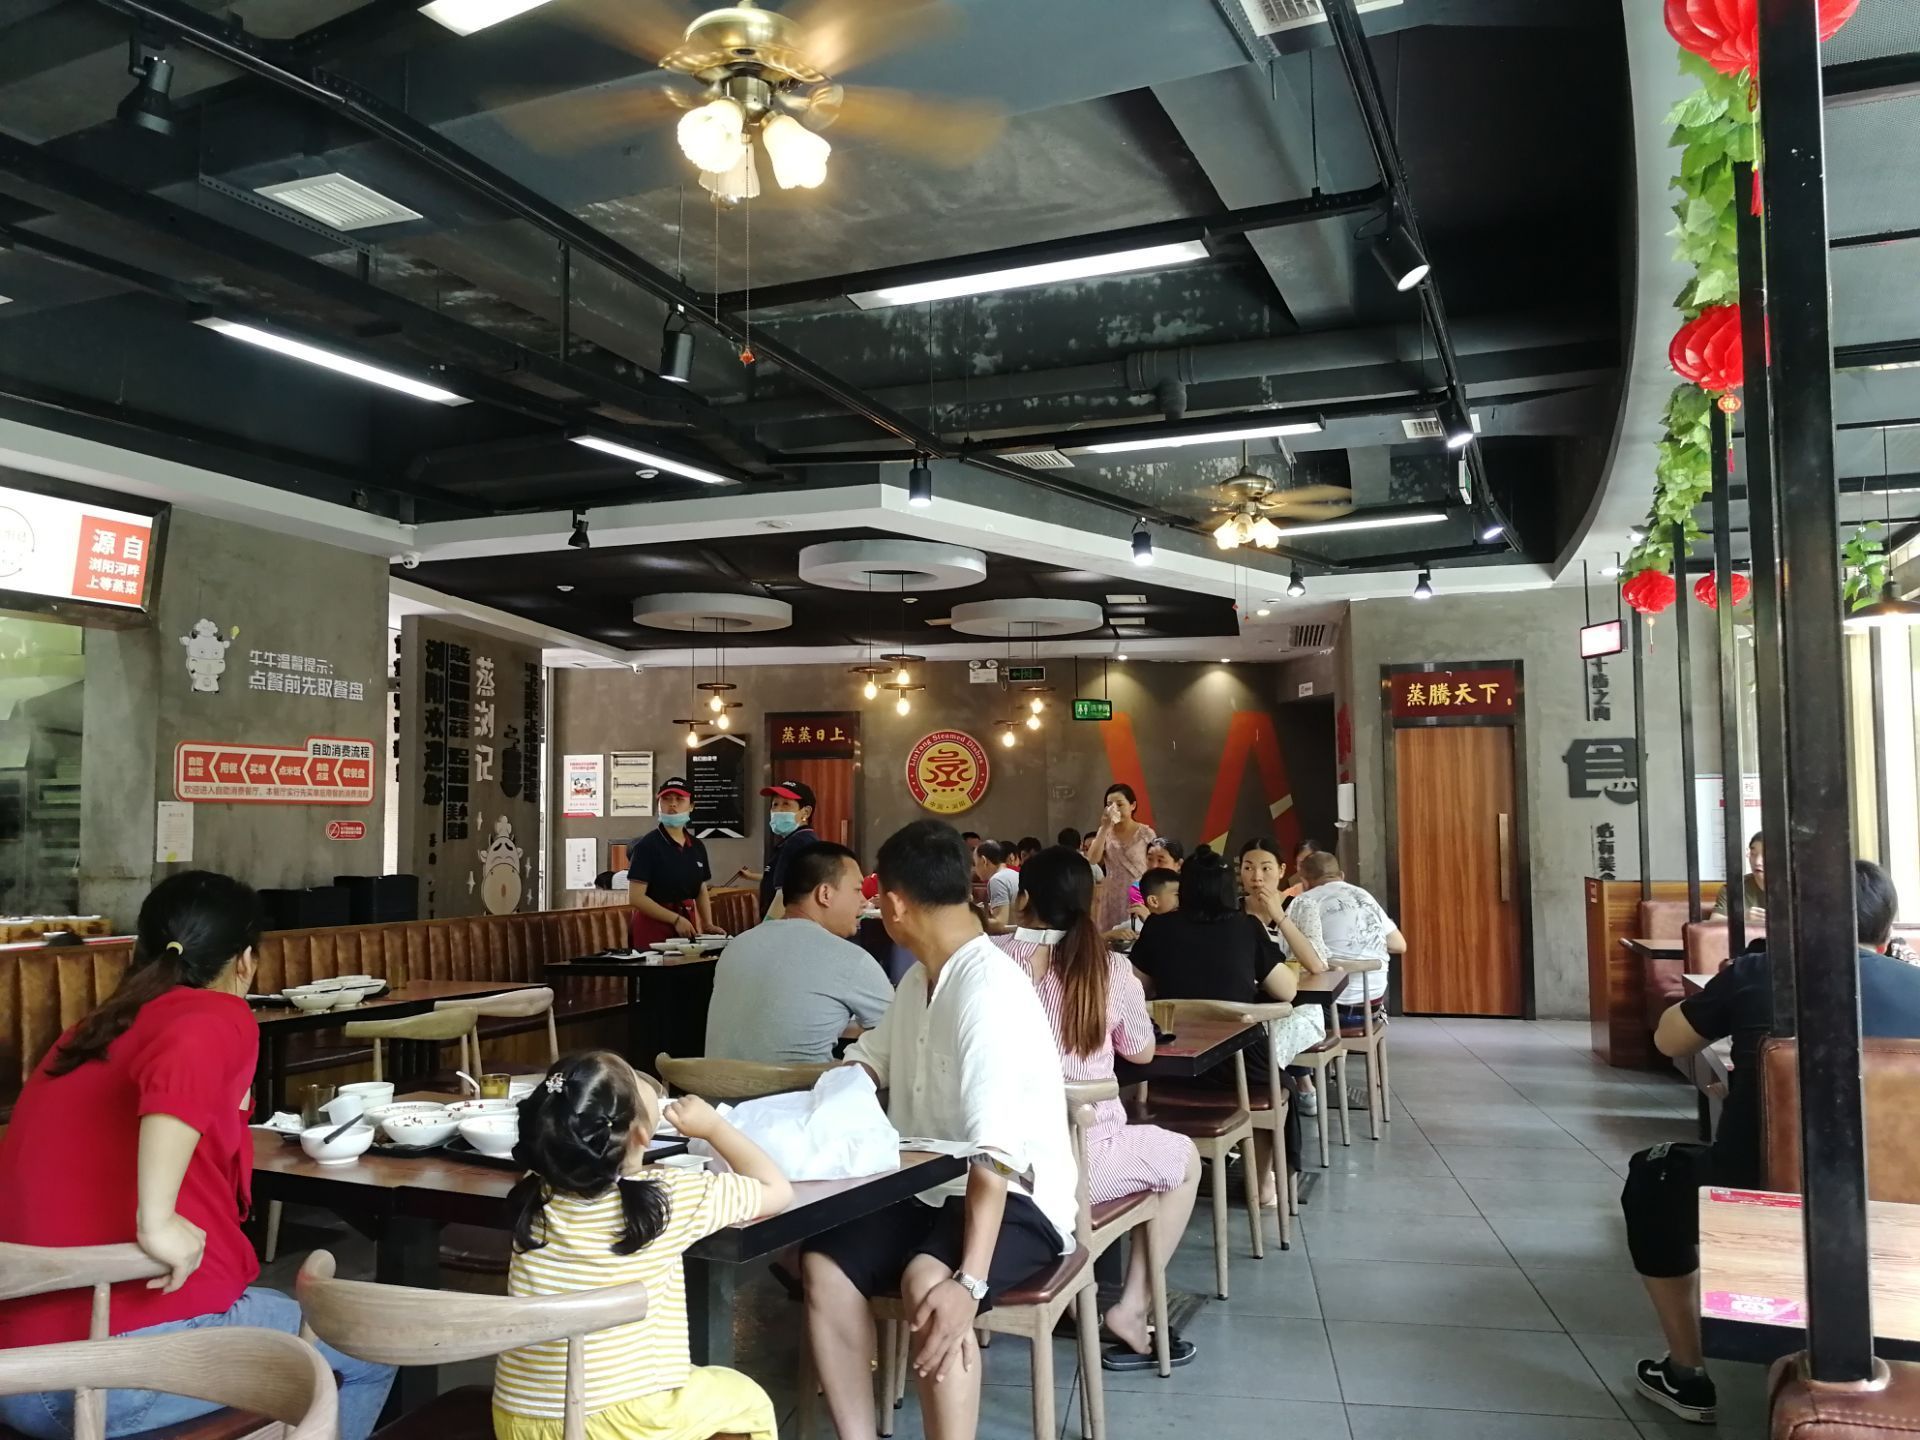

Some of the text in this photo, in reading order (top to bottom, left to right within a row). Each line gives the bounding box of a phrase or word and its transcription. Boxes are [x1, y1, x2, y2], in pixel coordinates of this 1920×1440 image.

[91, 529, 144, 561] 源自
[88, 557, 140, 578] 浏阳河畔
[85, 575, 138, 595] 上等蒸菜
[249, 670, 364, 701] 点餐前先取餐盘
[474, 656, 495, 782] 蒸浏记
[781, 726, 846, 744] 蒸蒸日上
[312, 743, 370, 759] 自助消费流程
[932, 732, 966, 743] Steamed
[966, 739, 984, 765] Dishes
